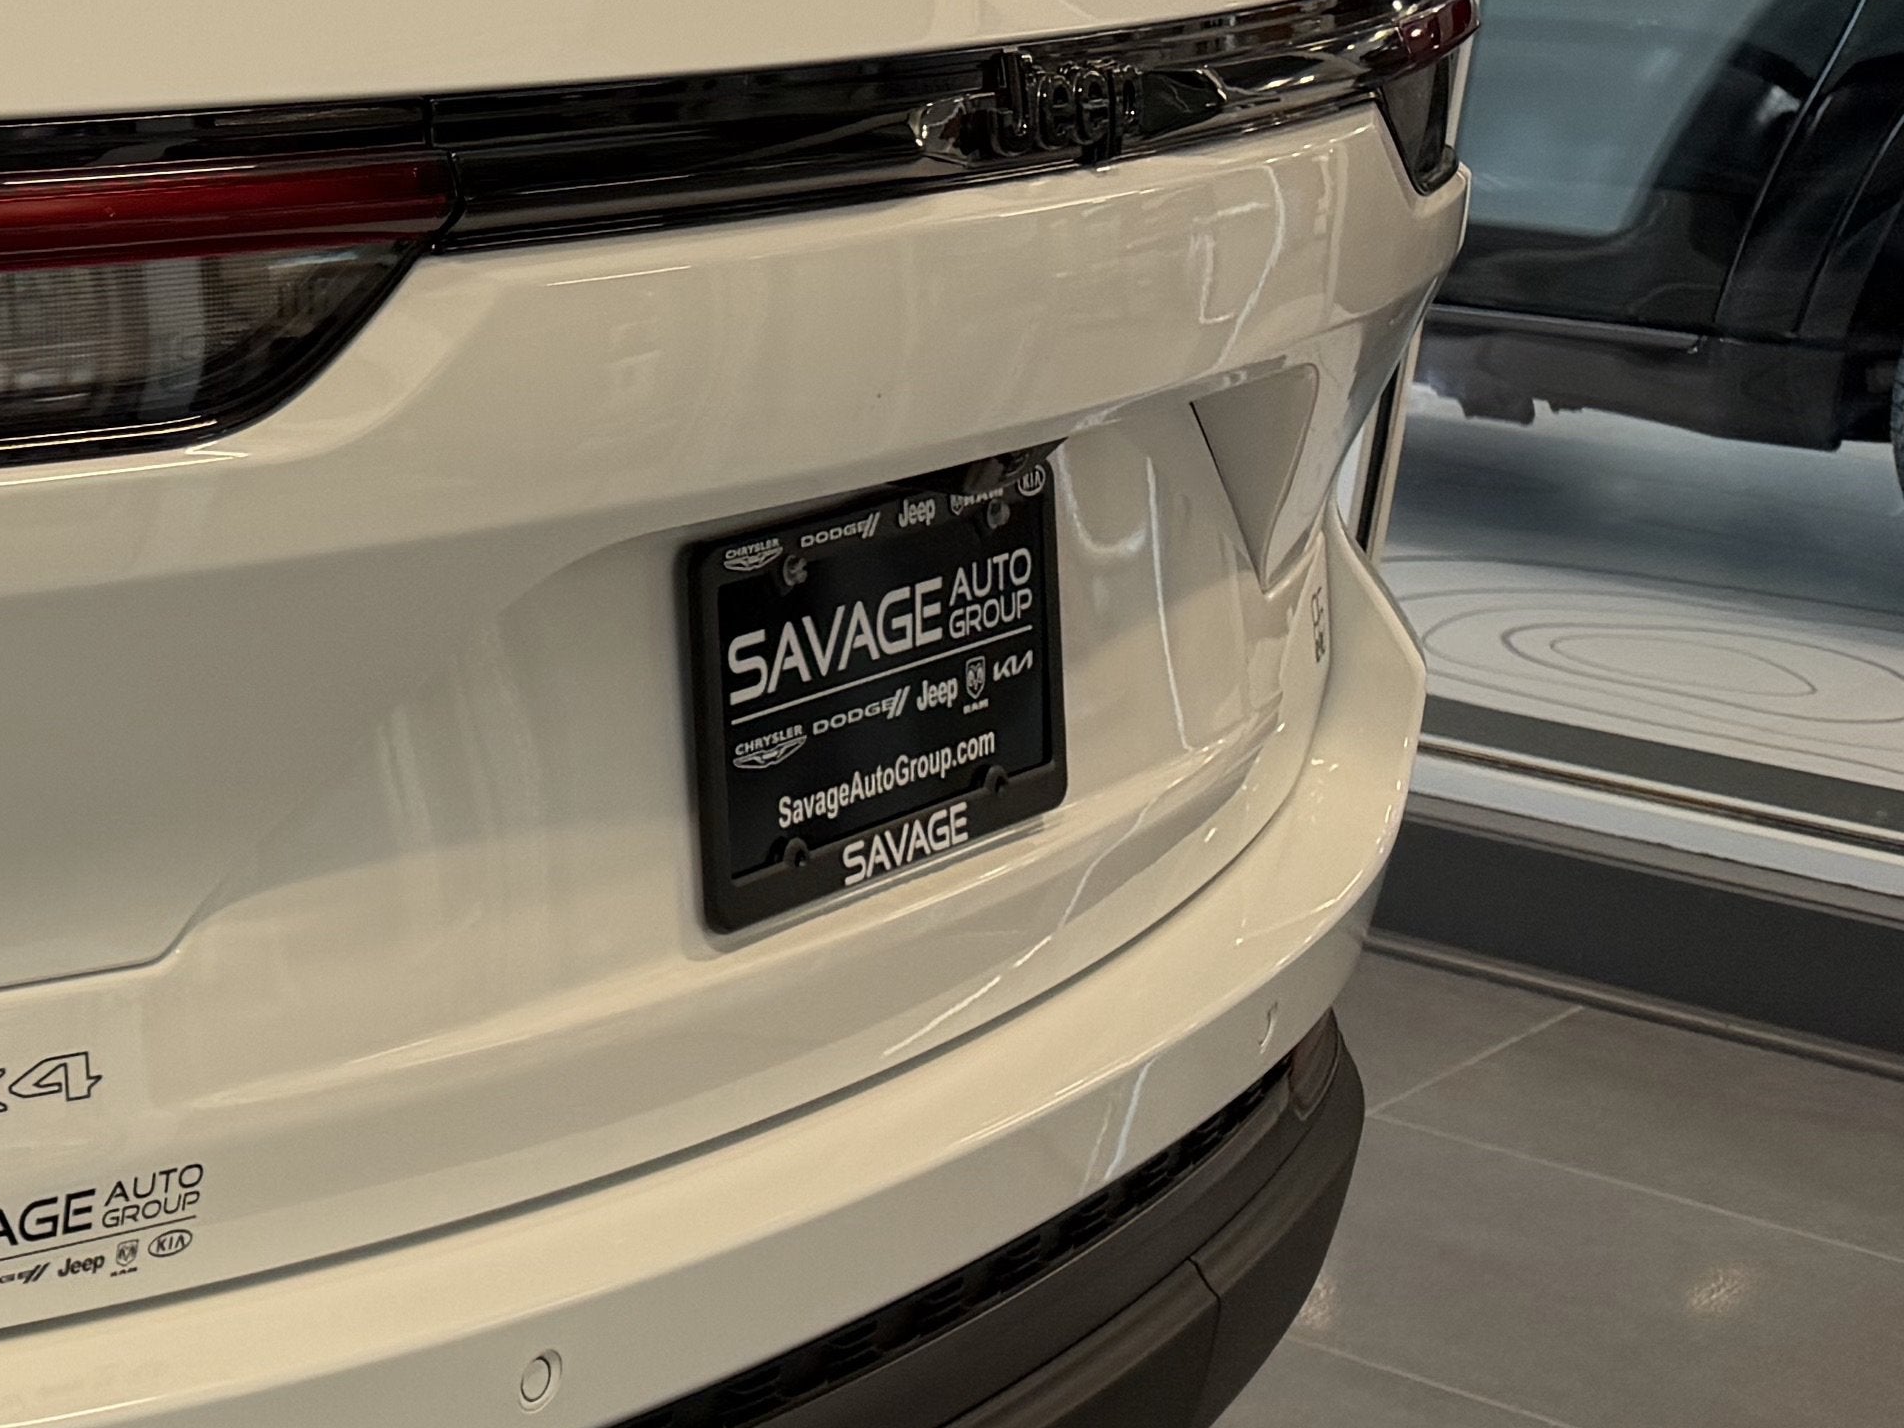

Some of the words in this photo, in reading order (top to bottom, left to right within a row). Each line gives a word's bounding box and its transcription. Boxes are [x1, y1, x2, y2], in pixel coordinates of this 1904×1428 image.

[989, 46, 1142, 169] Jeep
[724, 537, 780, 560] CHRYSLER
[801, 523, 866, 548] DODGE
[898, 498, 936, 527] Jeep
[950, 547, 1032, 601] AUTO
[728, 577, 943, 706] SAVAGE
[949, 590, 1033, 640] GROUP
[735, 726, 803, 755] CHRYSLER
[813, 697, 895, 734] DODGE
[917, 675, 958, 713] Jeep
[779, 730, 995, 829] SavageAutoGroup.com
[843, 803, 968, 886] SAVAGE
[102, 1191, 200, 1228] GROUP
[104, 1163, 204, 1206] AUTO
[57, 1254, 105, 1278] Jeep
[154, 1231, 188, 1254] KIA
